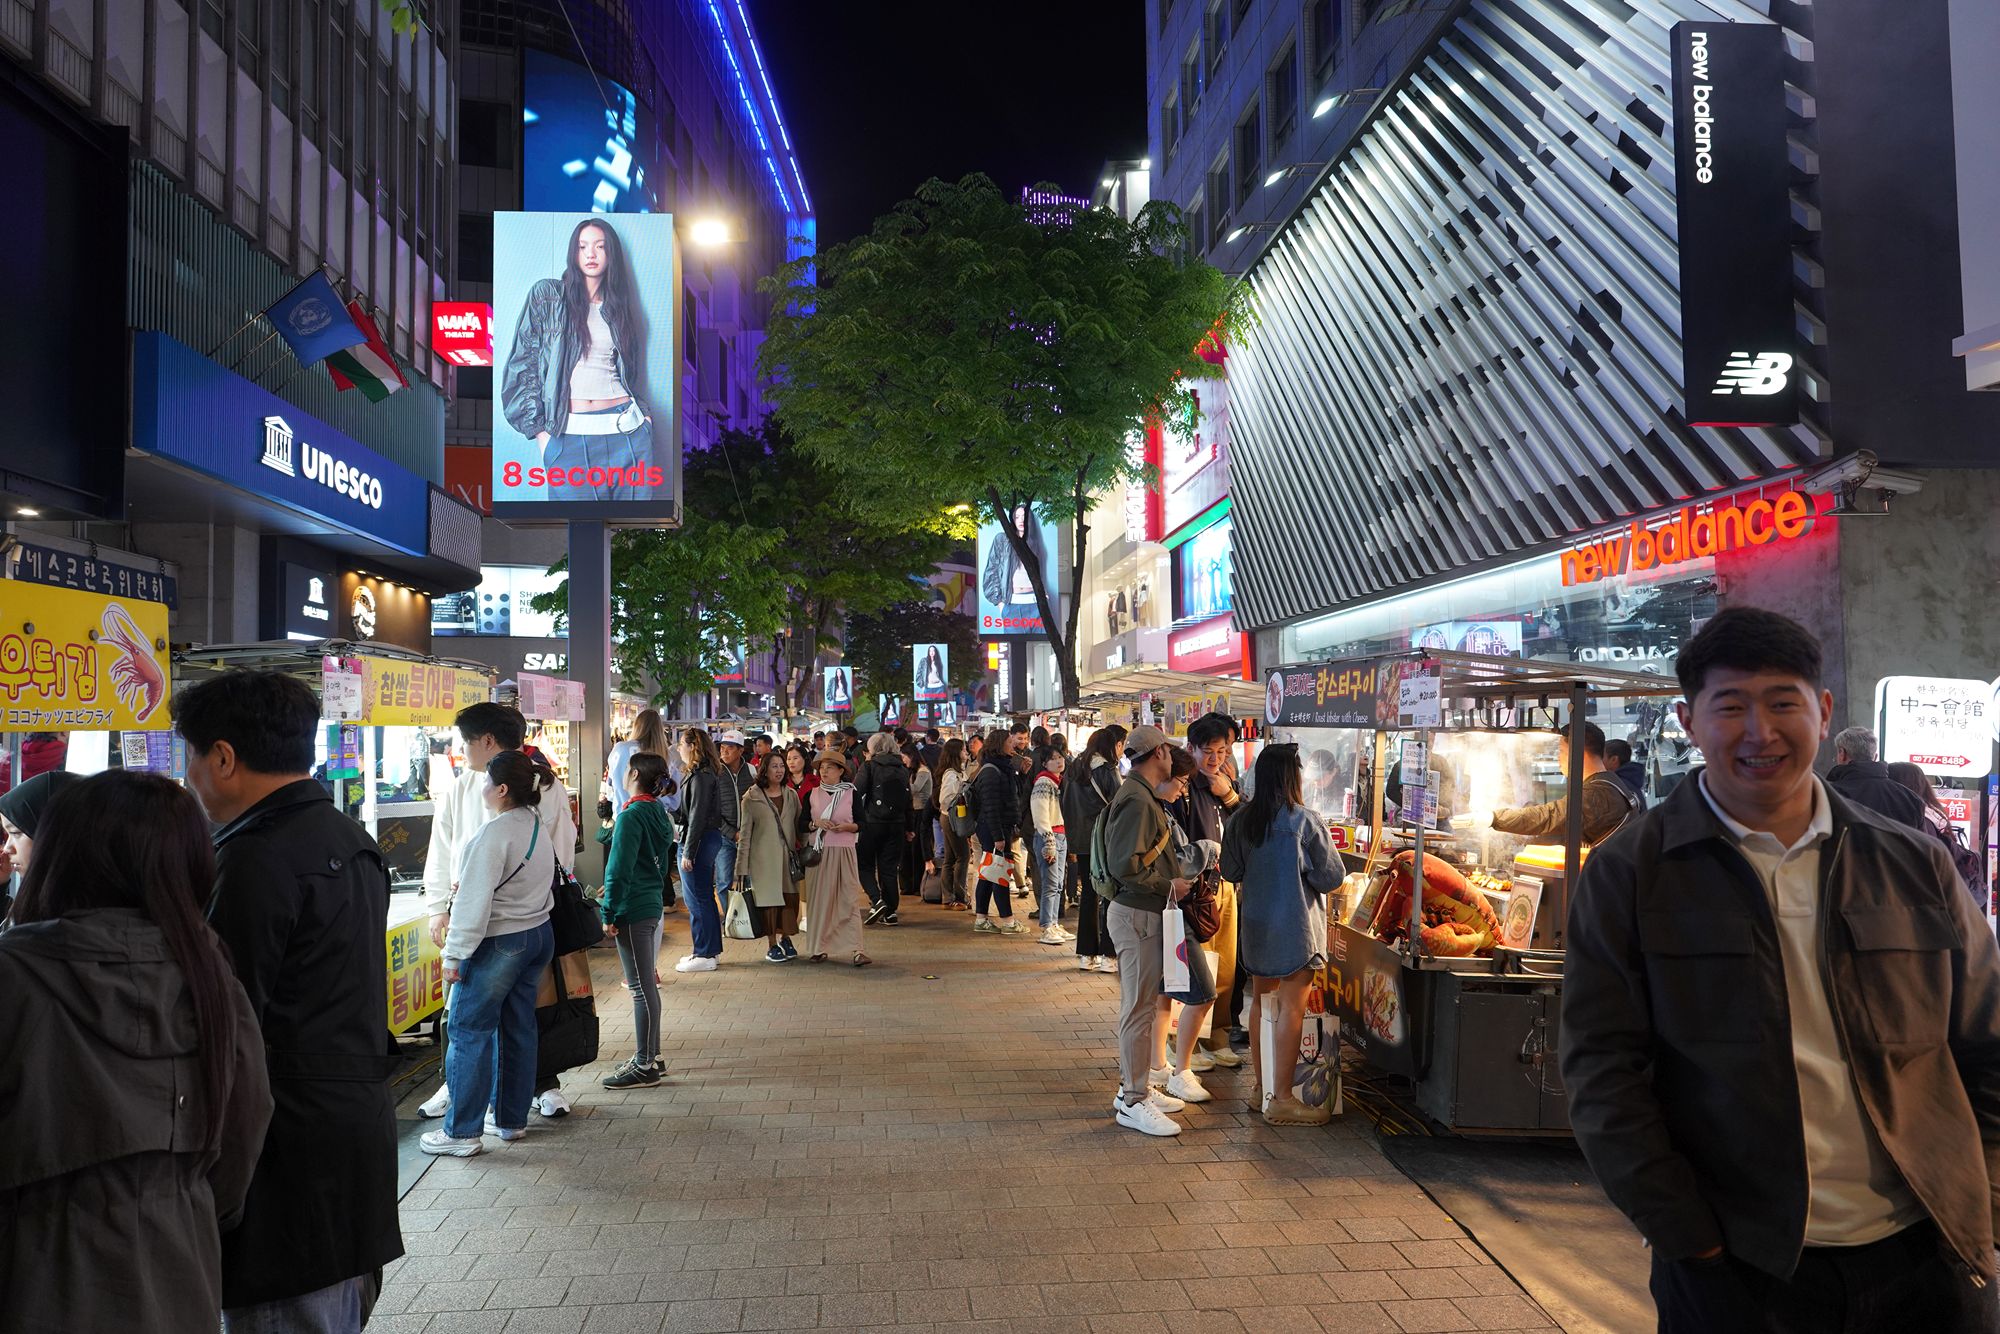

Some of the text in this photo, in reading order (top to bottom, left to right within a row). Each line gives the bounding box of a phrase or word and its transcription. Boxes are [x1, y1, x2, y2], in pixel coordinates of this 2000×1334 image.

[1691, 32, 1714, 184] new balance
[302, 442, 383, 510] unesco
[503, 461, 664, 487] 8 seconds
[1561, 491, 1809, 586] new balance
[16, 549, 164, 602] 네스코한국위원회
[984, 616, 992, 628] 8
[381, 671, 409, 706] 찹쌀
[409, 664, 455, 710] 붕어빵
[1316, 668, 1376, 705] 랍스터구이
[1900, 696, 1985, 717] 中一會館
[9, 709, 114, 724] ココナッツエビフライ
